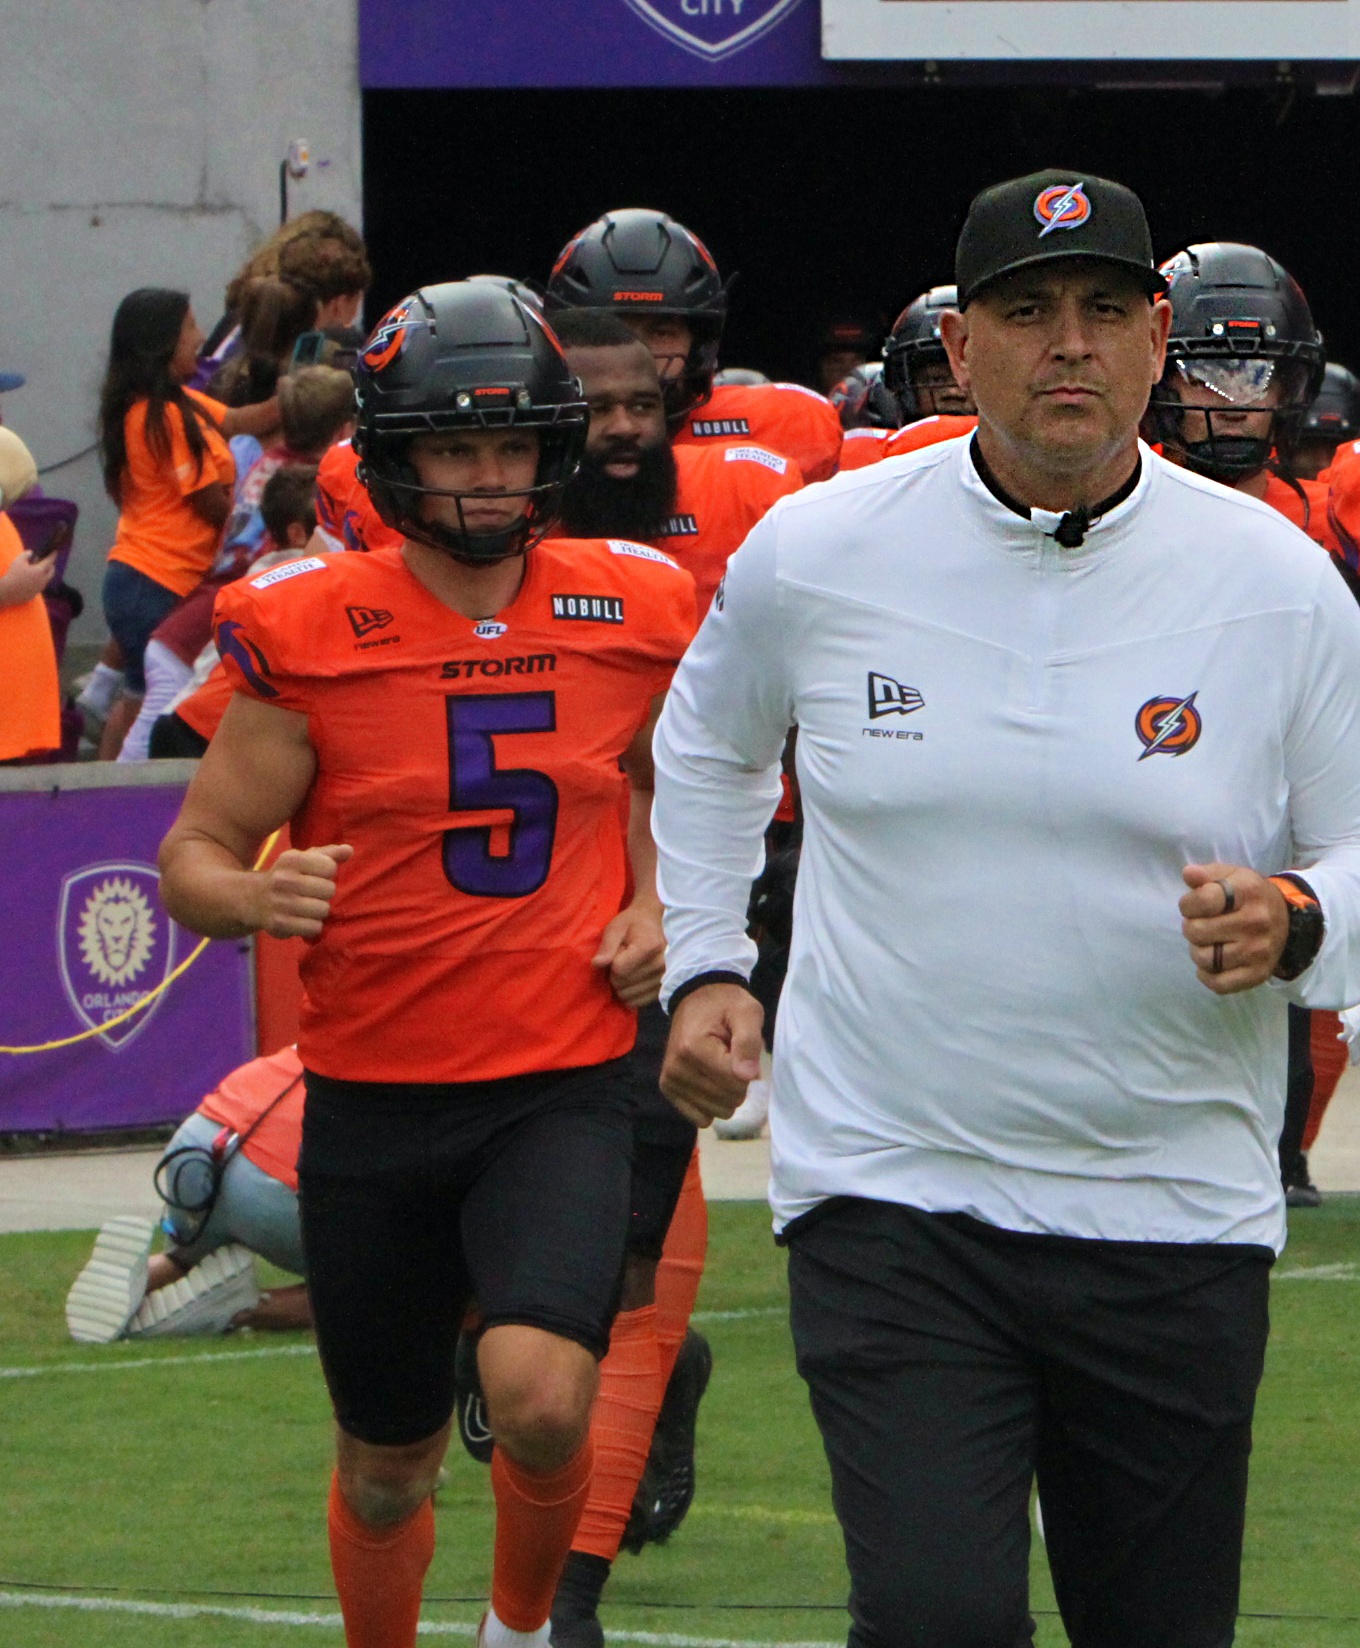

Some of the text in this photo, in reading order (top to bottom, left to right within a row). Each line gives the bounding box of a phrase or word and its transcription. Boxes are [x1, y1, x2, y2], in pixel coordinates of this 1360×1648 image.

[613, 291, 665, 301] STORM
[693, 420, 749, 435] NOBULL
[553, 597, 623, 621] NOBULL
[475, 624, 507, 637] UFL
[439, 652, 557, 681] STORM
[441, 689, 559, 899] 5
